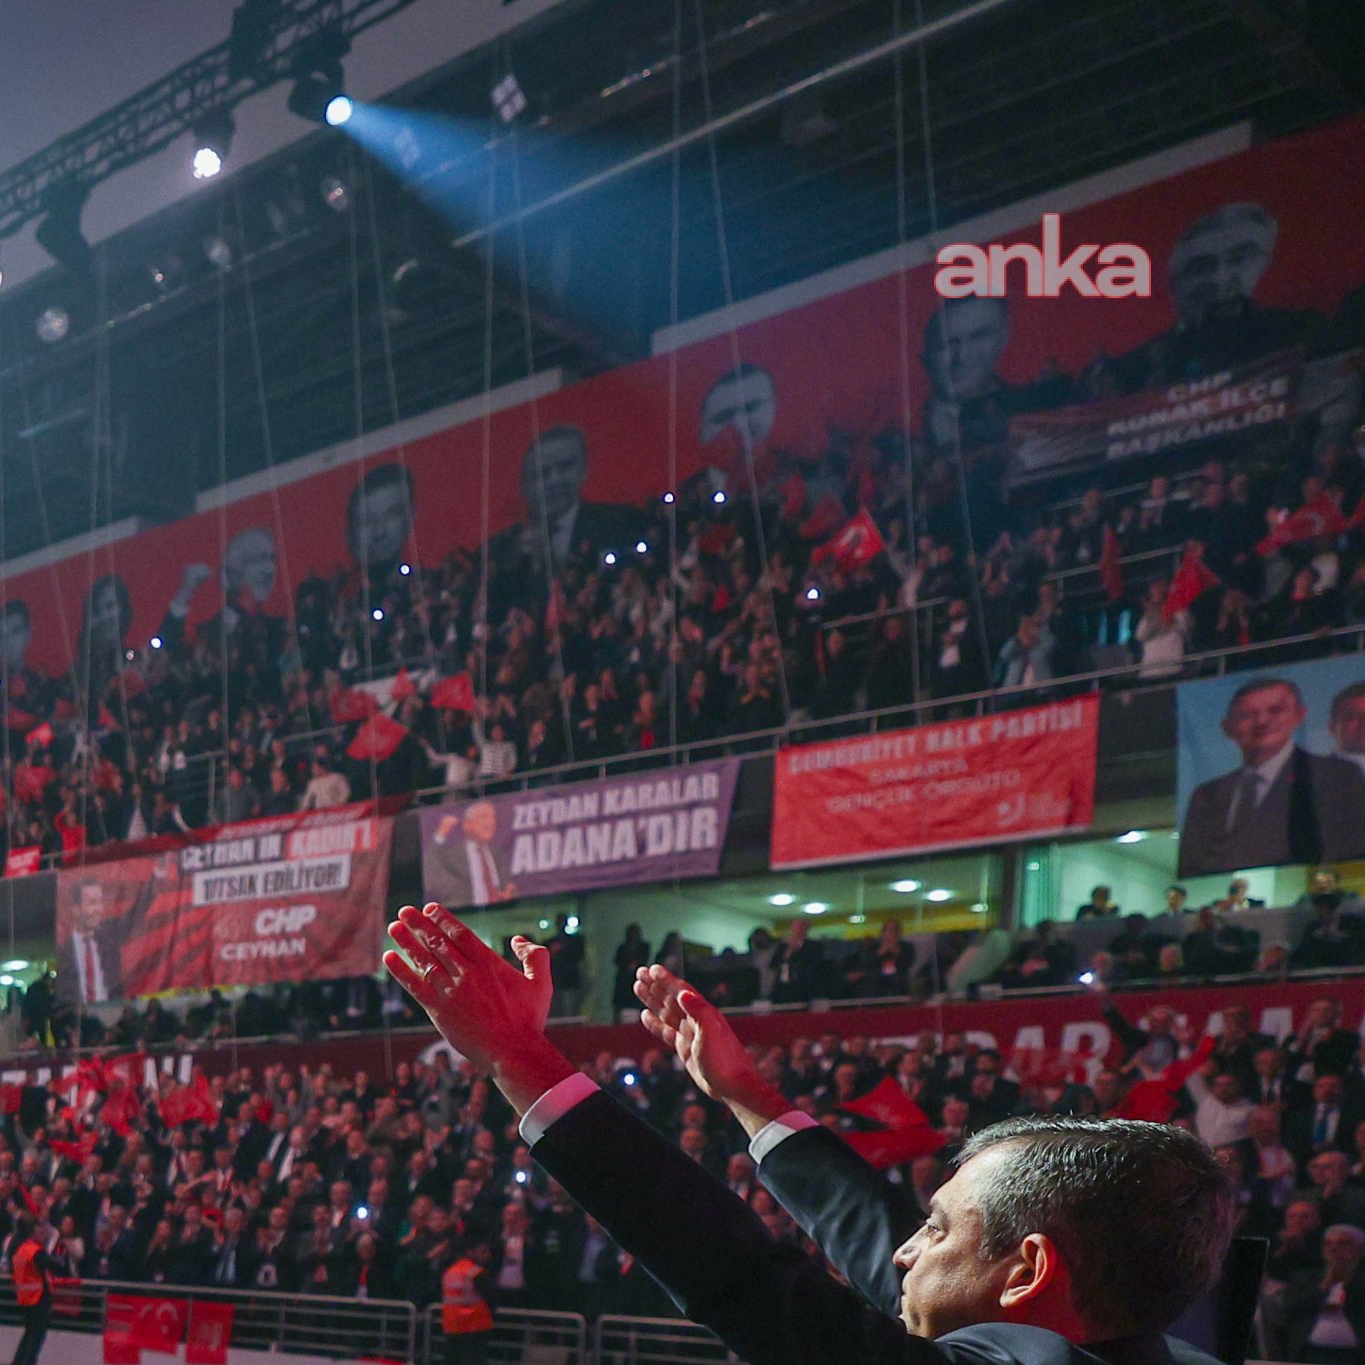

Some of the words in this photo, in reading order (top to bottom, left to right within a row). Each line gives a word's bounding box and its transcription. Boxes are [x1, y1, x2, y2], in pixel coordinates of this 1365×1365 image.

[1168, 371, 1232, 403] CHP
[1107, 401, 1210, 434] KONAK
[512, 790, 600, 831] ZEYDAN
[603, 772, 720, 816] KARALAR
[510, 806, 719, 875] ADANA'DIR
[255, 904, 318, 935] CHP
[220, 938, 307, 961] CEYHAN
